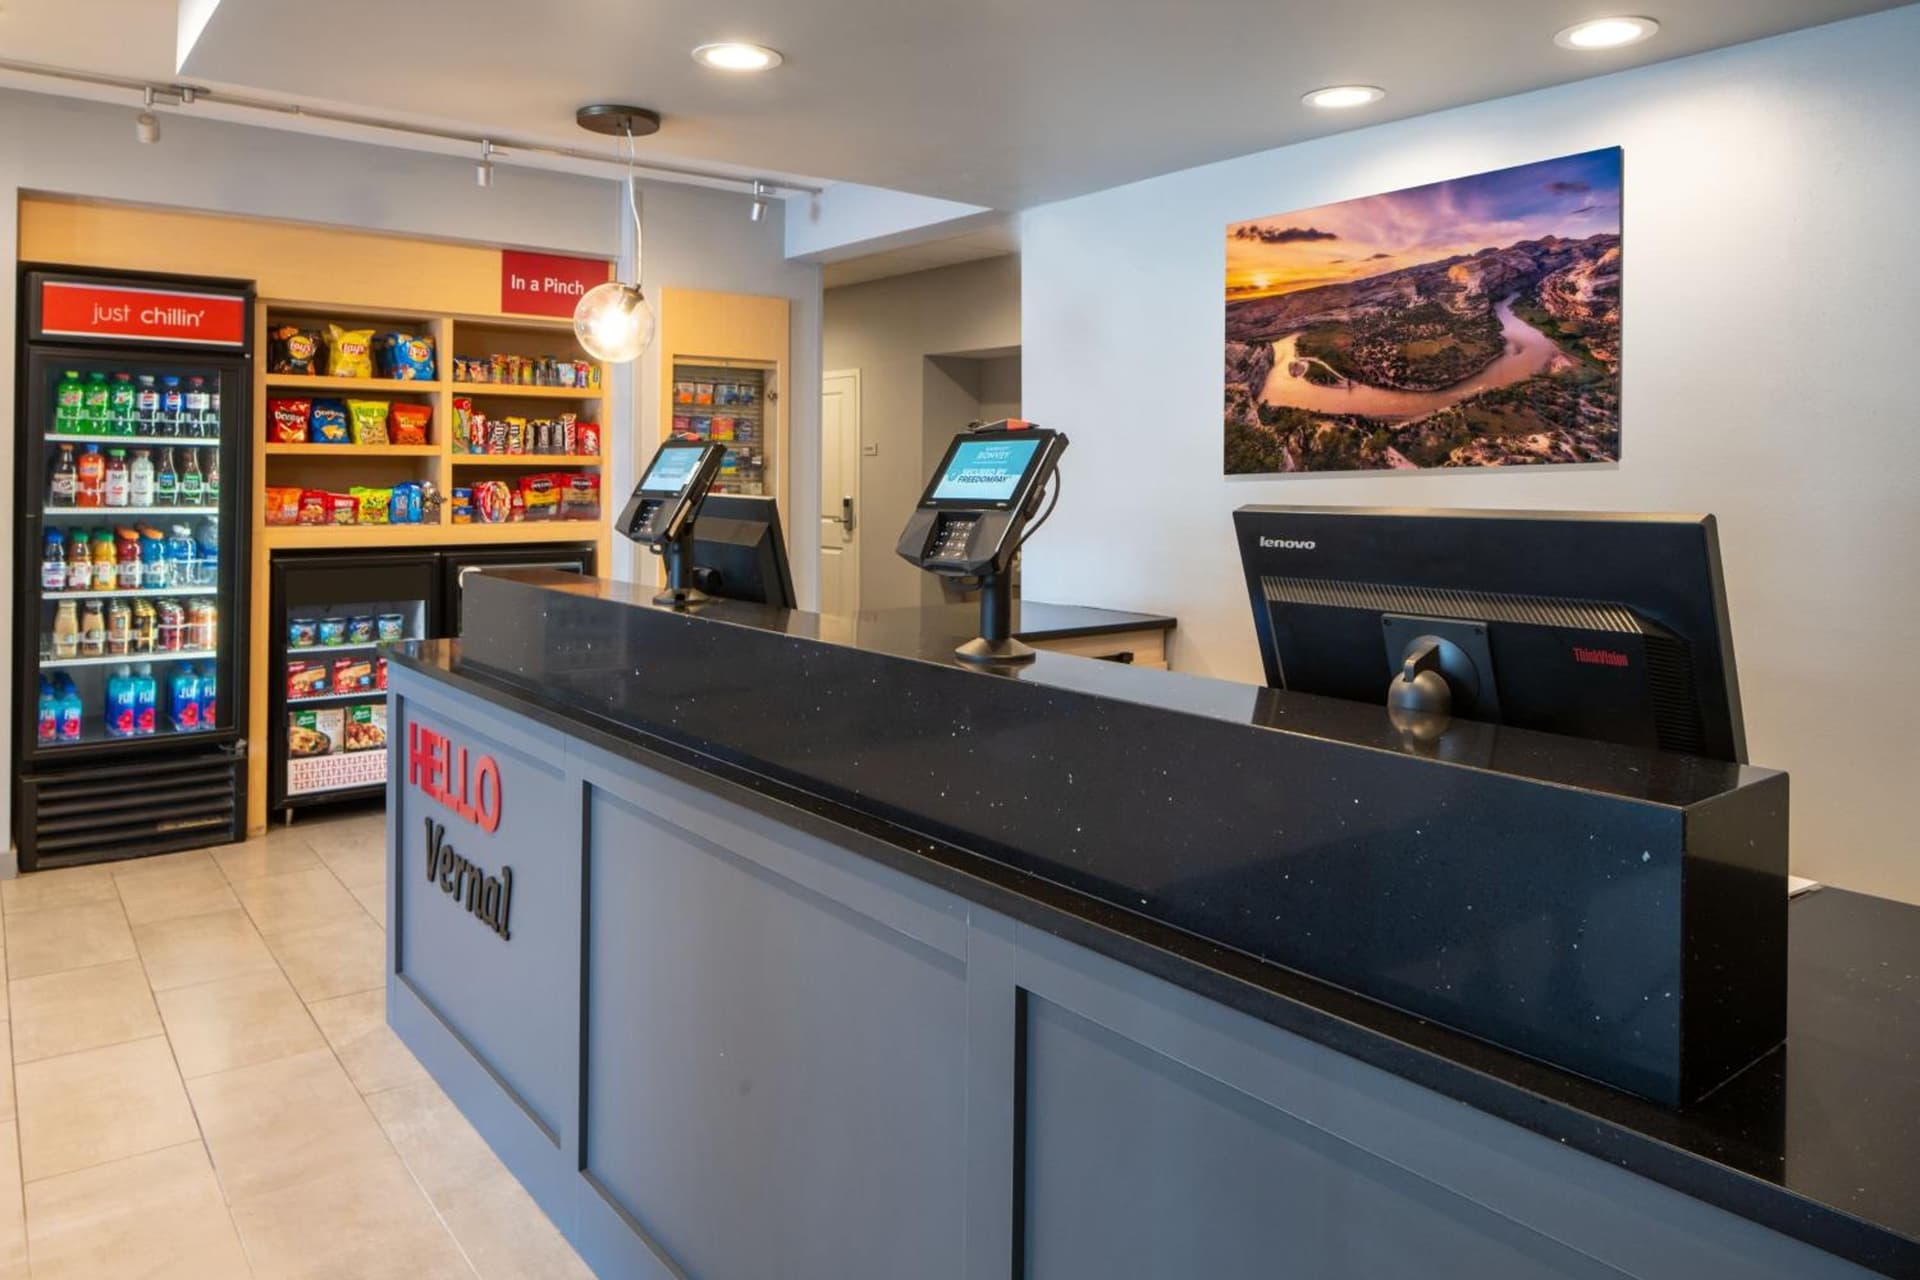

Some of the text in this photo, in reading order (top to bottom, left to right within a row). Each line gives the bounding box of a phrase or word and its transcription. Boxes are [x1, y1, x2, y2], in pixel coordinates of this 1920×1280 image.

[511, 274, 584, 295] In a Pinch
[92, 303, 130, 325] just
[1259, 535, 1317, 550] lenovo
[408, 720, 502, 834] HELLO
[424, 816, 513, 942] Vernal
